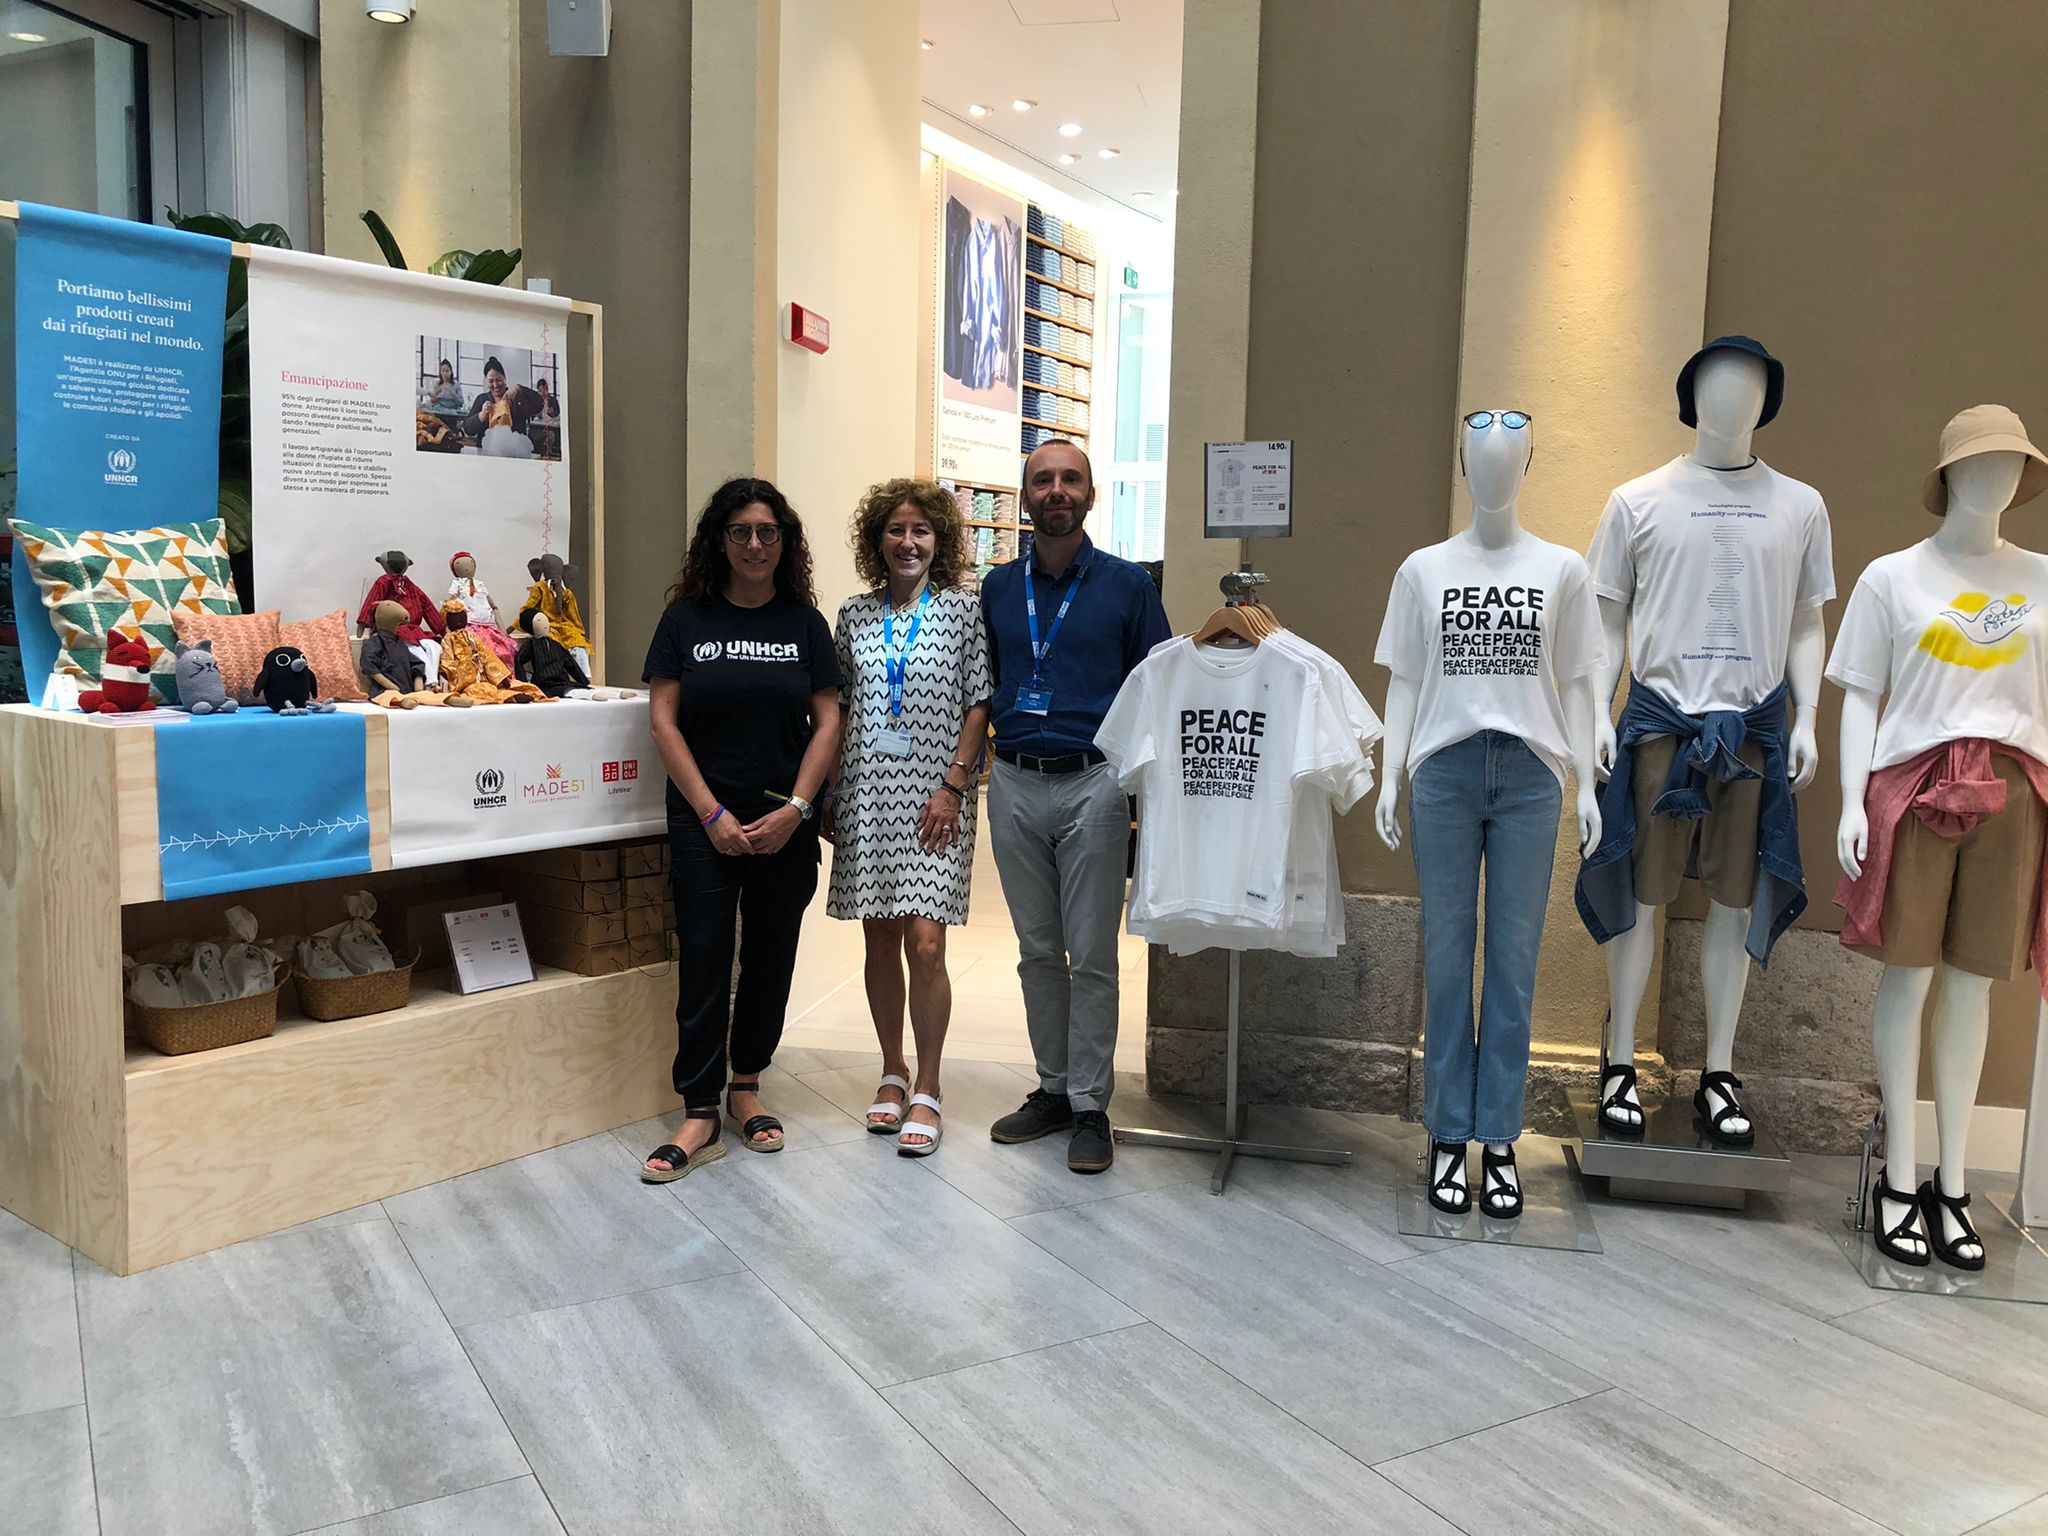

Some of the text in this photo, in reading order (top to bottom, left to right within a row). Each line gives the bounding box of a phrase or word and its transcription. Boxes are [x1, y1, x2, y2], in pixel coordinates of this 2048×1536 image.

[58, 278, 191, 311] Portiamo bellissimi
[76, 305, 174, 328] prodotti creati
[43, 318, 204, 350] dai rifugiati nel mondo.
[281, 370, 368, 390] Emancipazione
[297, 395, 313, 403] degli
[306, 404, 338, 412] Attraverso
[305, 420, 335, 428] l'esempio
[336, 423, 360, 431] positivo
[310, 446, 342, 454] artigianale
[354, 448, 392, 457] l'opportunità
[105, 474, 138, 482] UNHCR
[371, 473, 391, 481] Spesso
[1443, 586, 1543, 611] PEACE
[1442, 610, 1540, 631] FOR ALL
[727, 641, 798, 656] UNHCR
[1444, 647, 1539, 658] FOR ALL FOR ALL
[1181, 710, 1266, 737] PEACE
[1181, 735, 1260, 758] FOR ALL
[624, 761, 636, 769] UNI
[624, 770, 636, 778] QLO
[1183, 770, 1204, 779] FOR
[1206, 770, 1224, 779] ALL
[1225, 771, 1239, 780] FOR
[523, 779, 584, 797] MADE51
[608, 786, 632, 795] LifeWear
[473, 795, 507, 806] UNHCR
